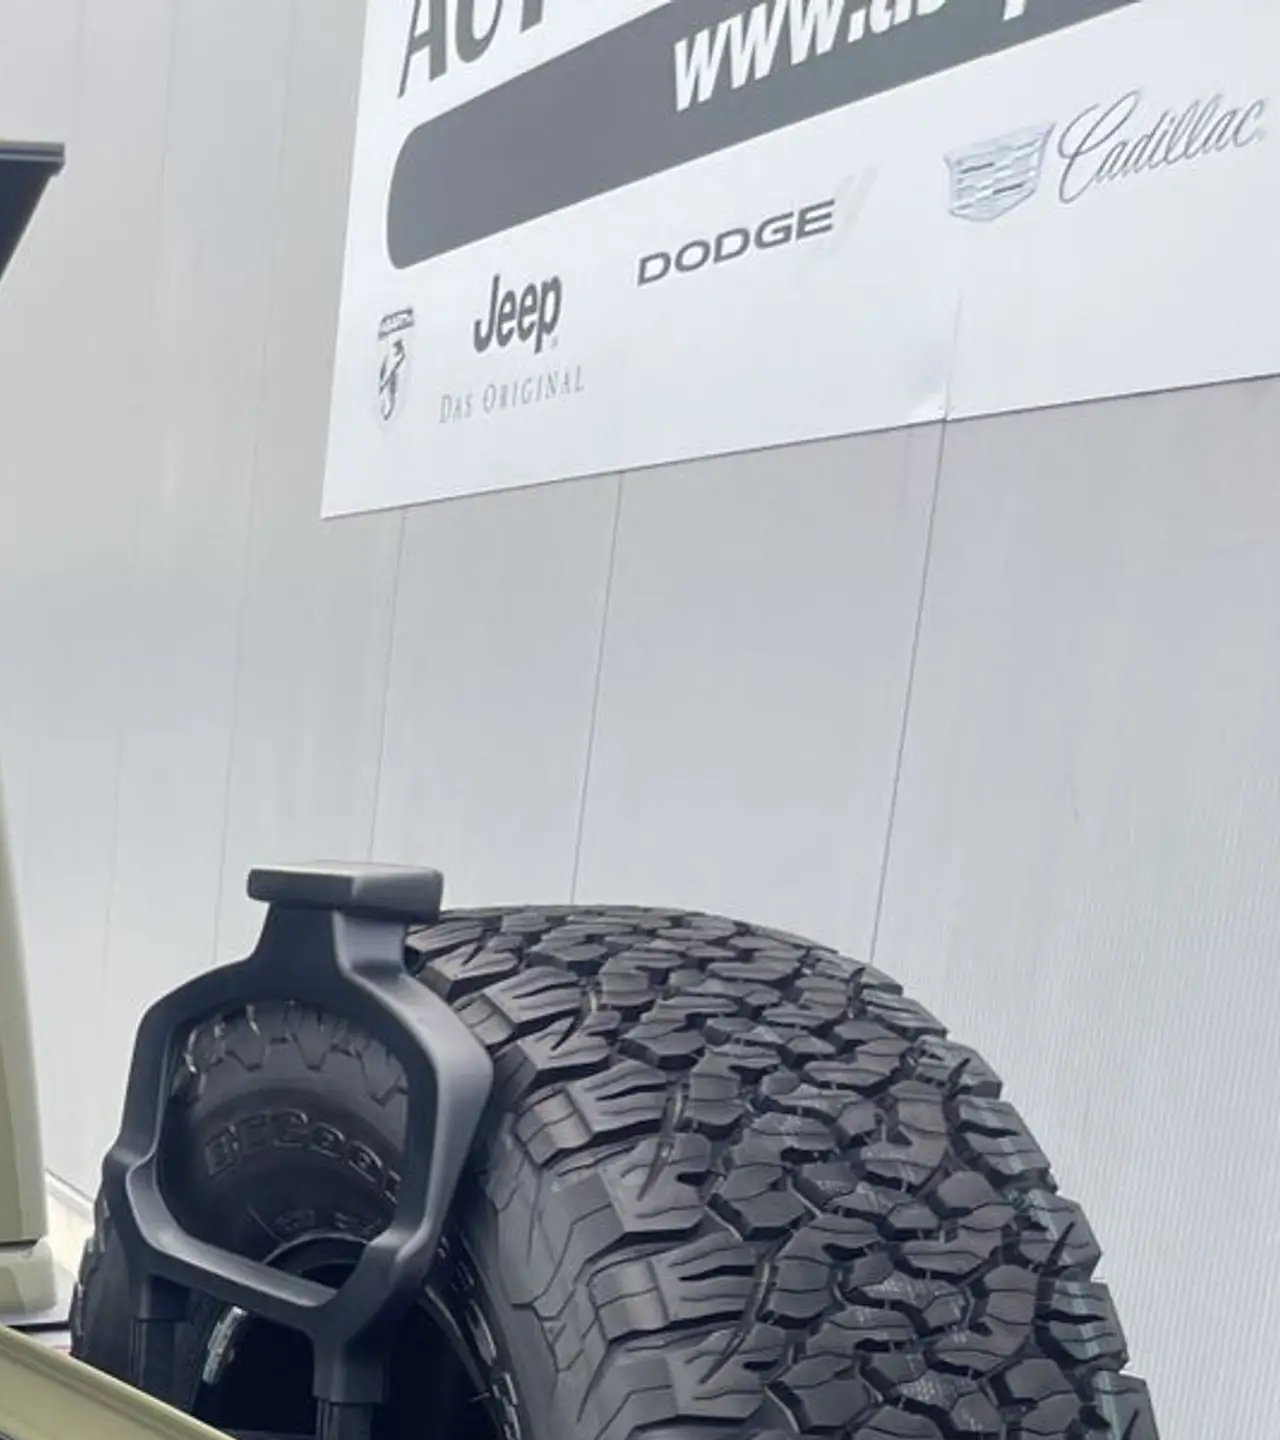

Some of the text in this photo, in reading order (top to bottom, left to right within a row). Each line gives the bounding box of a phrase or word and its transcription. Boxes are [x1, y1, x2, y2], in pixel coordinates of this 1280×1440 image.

[1057, 88, 1265, 205] Cadillac
[637, 199, 836, 287] DODGE
[474, 273, 562, 354] Jeep
